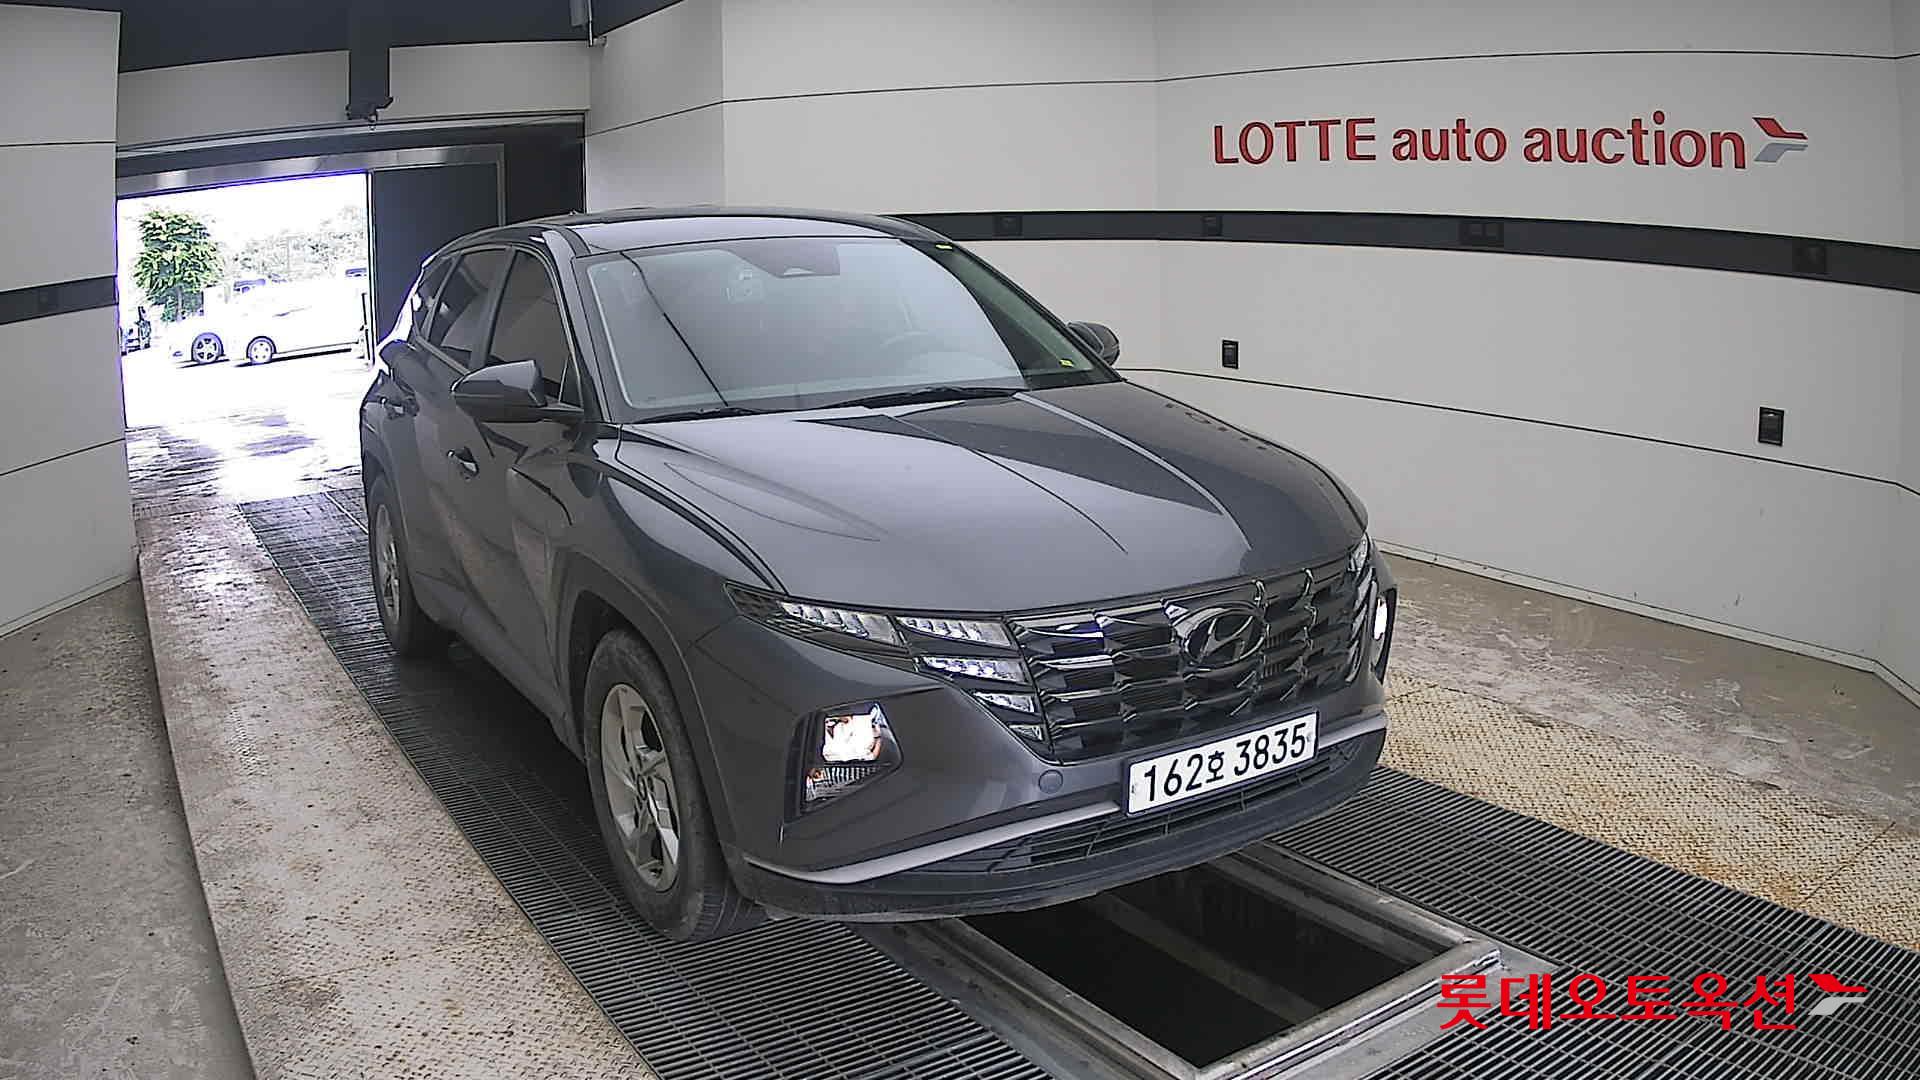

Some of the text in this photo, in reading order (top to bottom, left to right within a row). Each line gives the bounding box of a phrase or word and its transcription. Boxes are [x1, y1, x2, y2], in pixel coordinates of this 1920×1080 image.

[1213, 110, 1747, 169] LOTTE auto auction
[1144, 722, 1307, 802] 162호 3835
